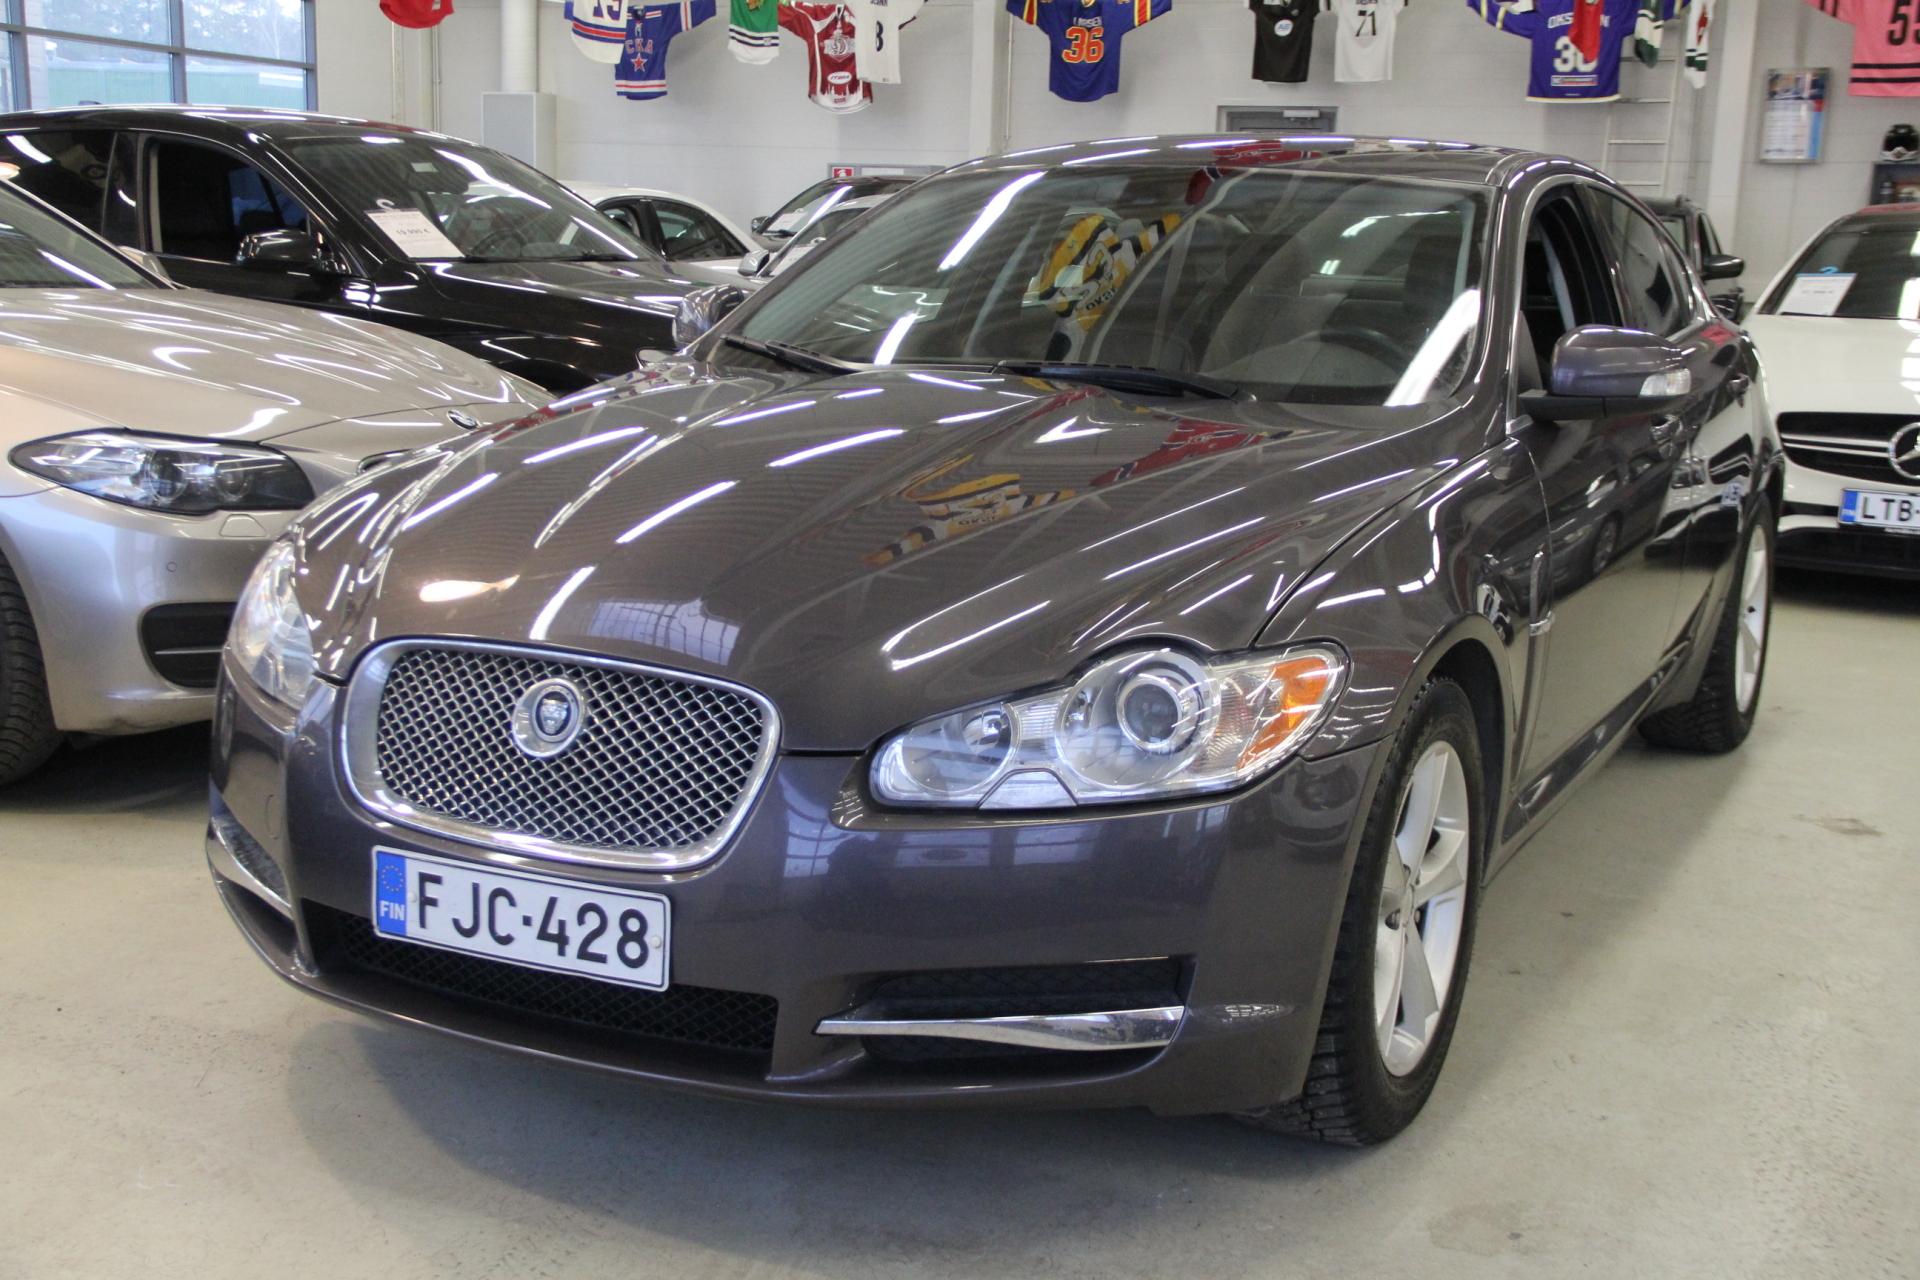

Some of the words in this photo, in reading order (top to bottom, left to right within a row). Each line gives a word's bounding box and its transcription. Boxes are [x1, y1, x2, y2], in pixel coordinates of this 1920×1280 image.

[1062, 26, 1104, 63] 36
[380, 900, 405, 921] FIN
[418, 871, 649, 968] FJC-428
